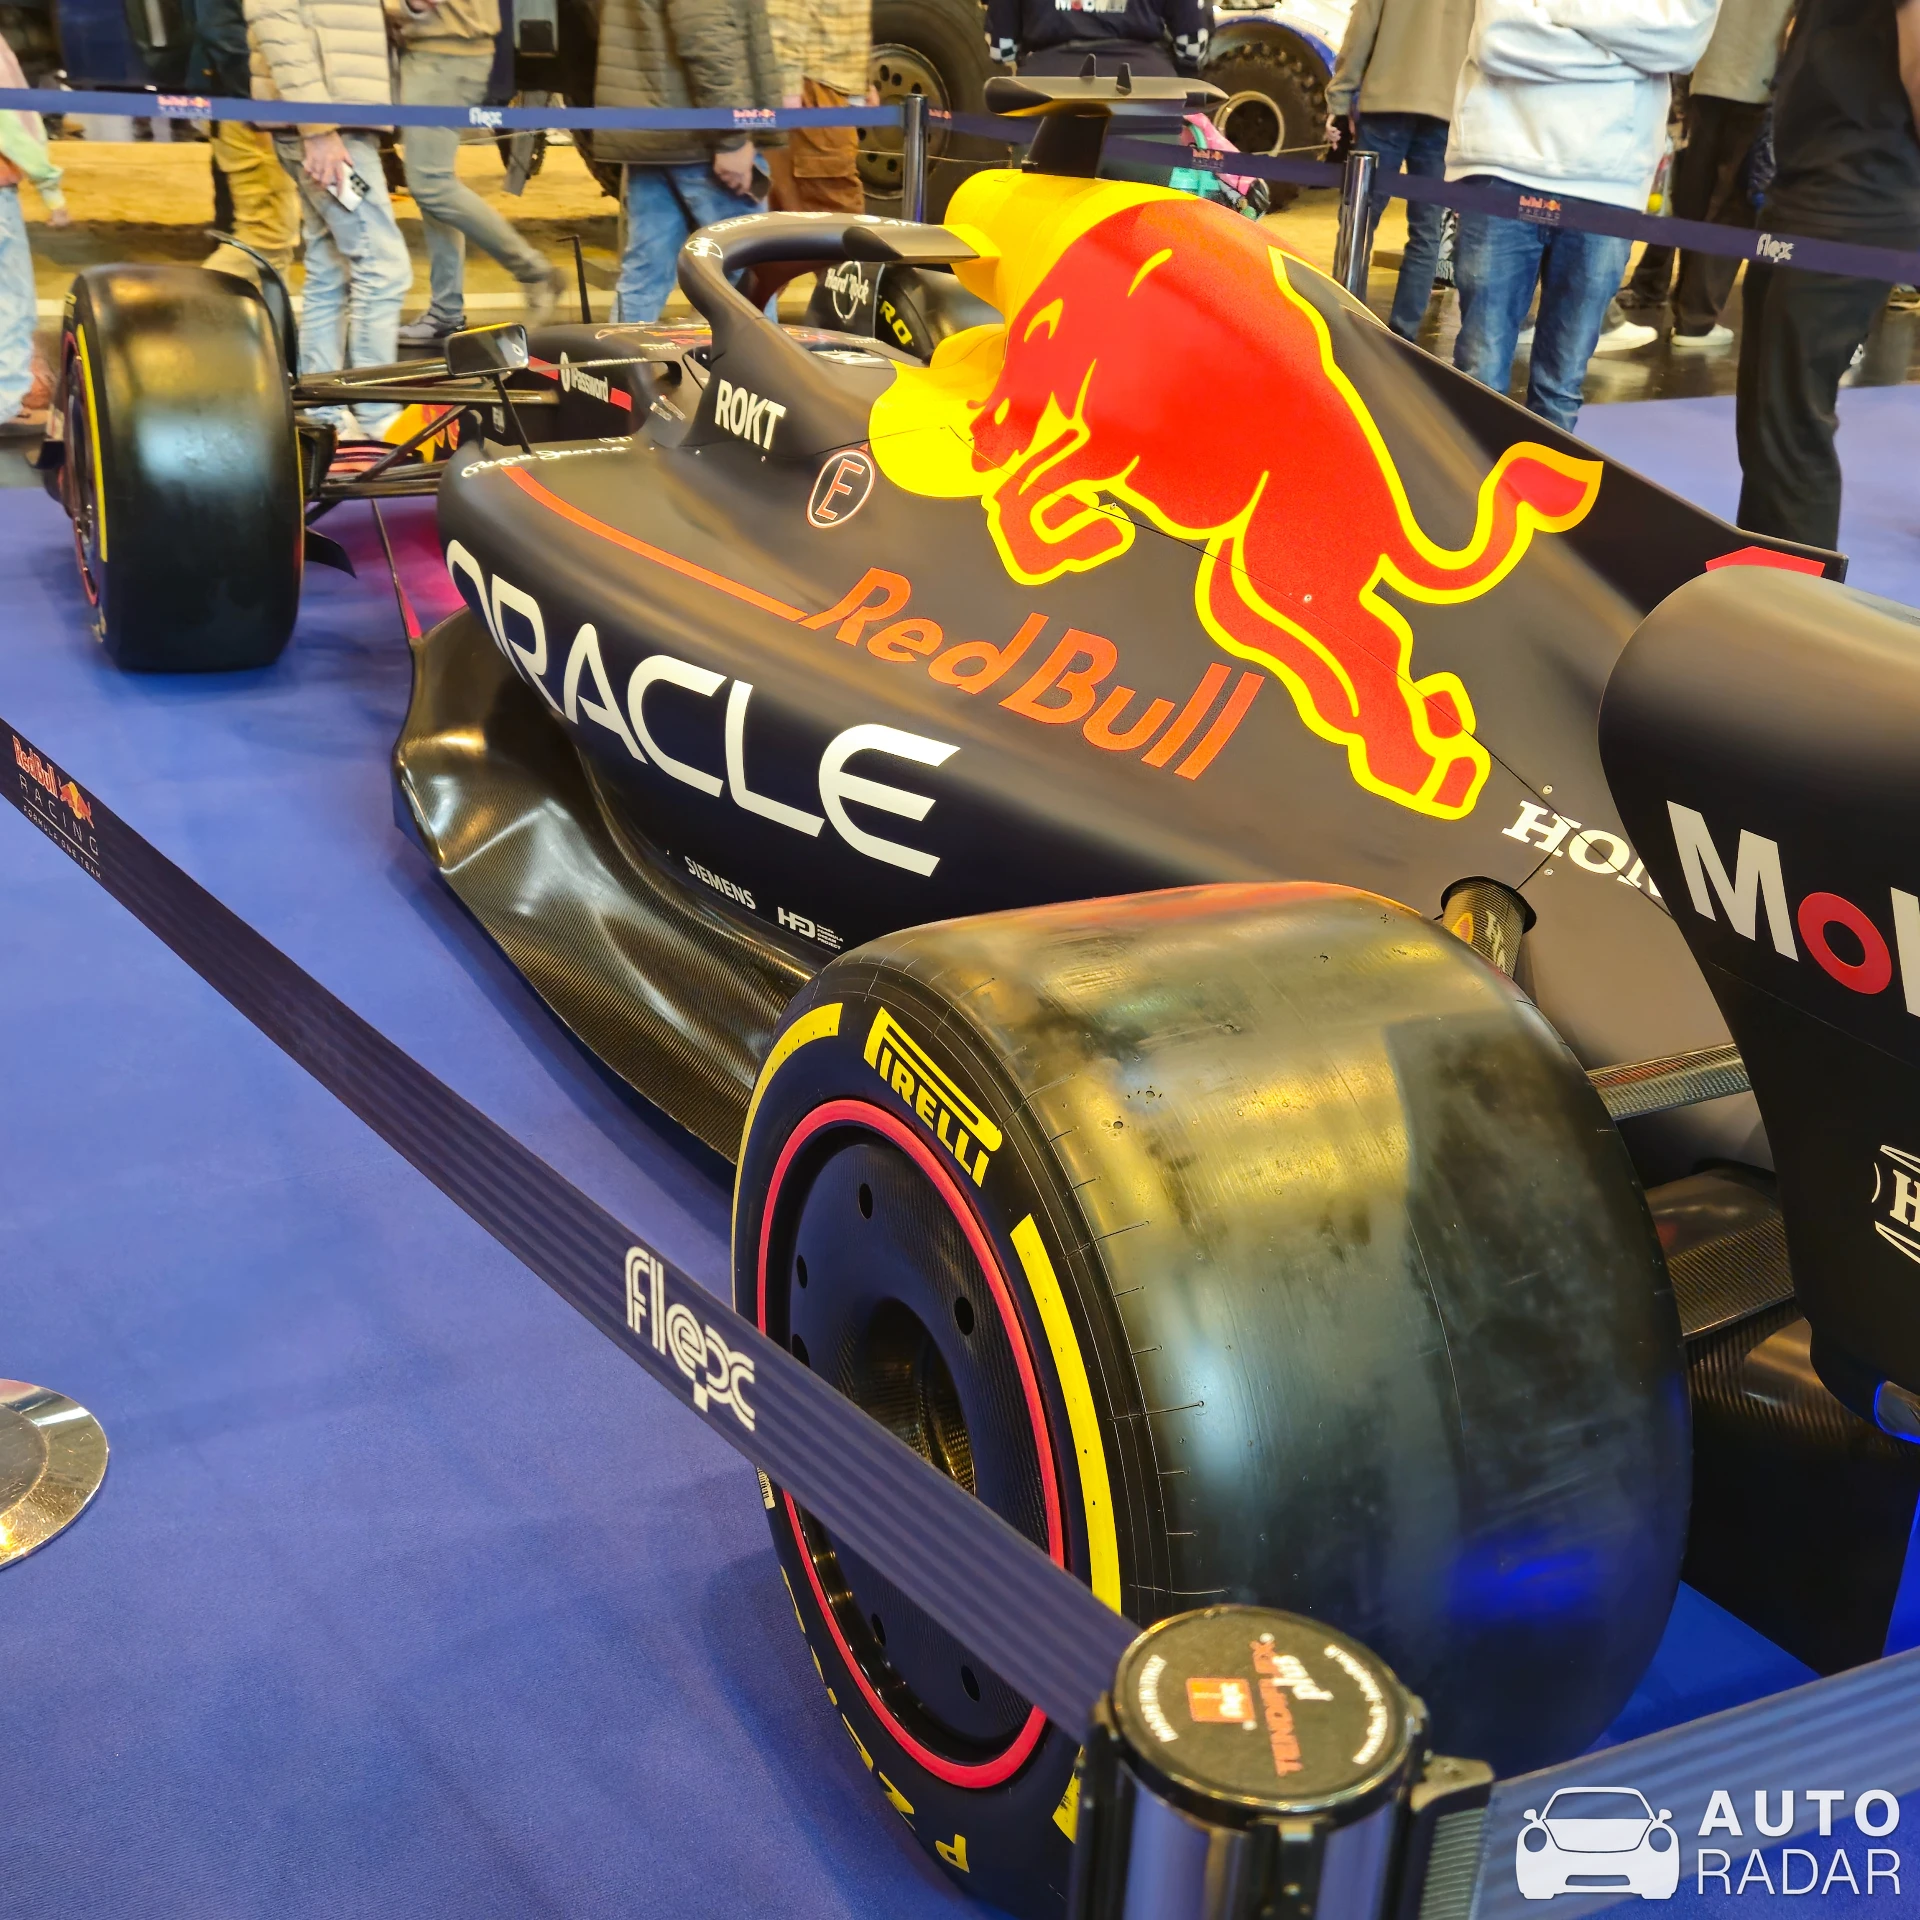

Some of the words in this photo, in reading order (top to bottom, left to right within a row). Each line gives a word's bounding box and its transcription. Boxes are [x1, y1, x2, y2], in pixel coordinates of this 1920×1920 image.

[714, 378, 787, 451] ROKT
[815, 458, 866, 521] E
[445, 538, 962, 877] ORACLE
[799, 566, 1050, 695] Red
[997, 628, 1266, 781] Bull
[18, 772, 99, 857] RACING
[684, 855, 757, 910] SIEMENS
[863, 1005, 1003, 1189] PIRELLI
[1270, 1655, 1335, 1701] plus
